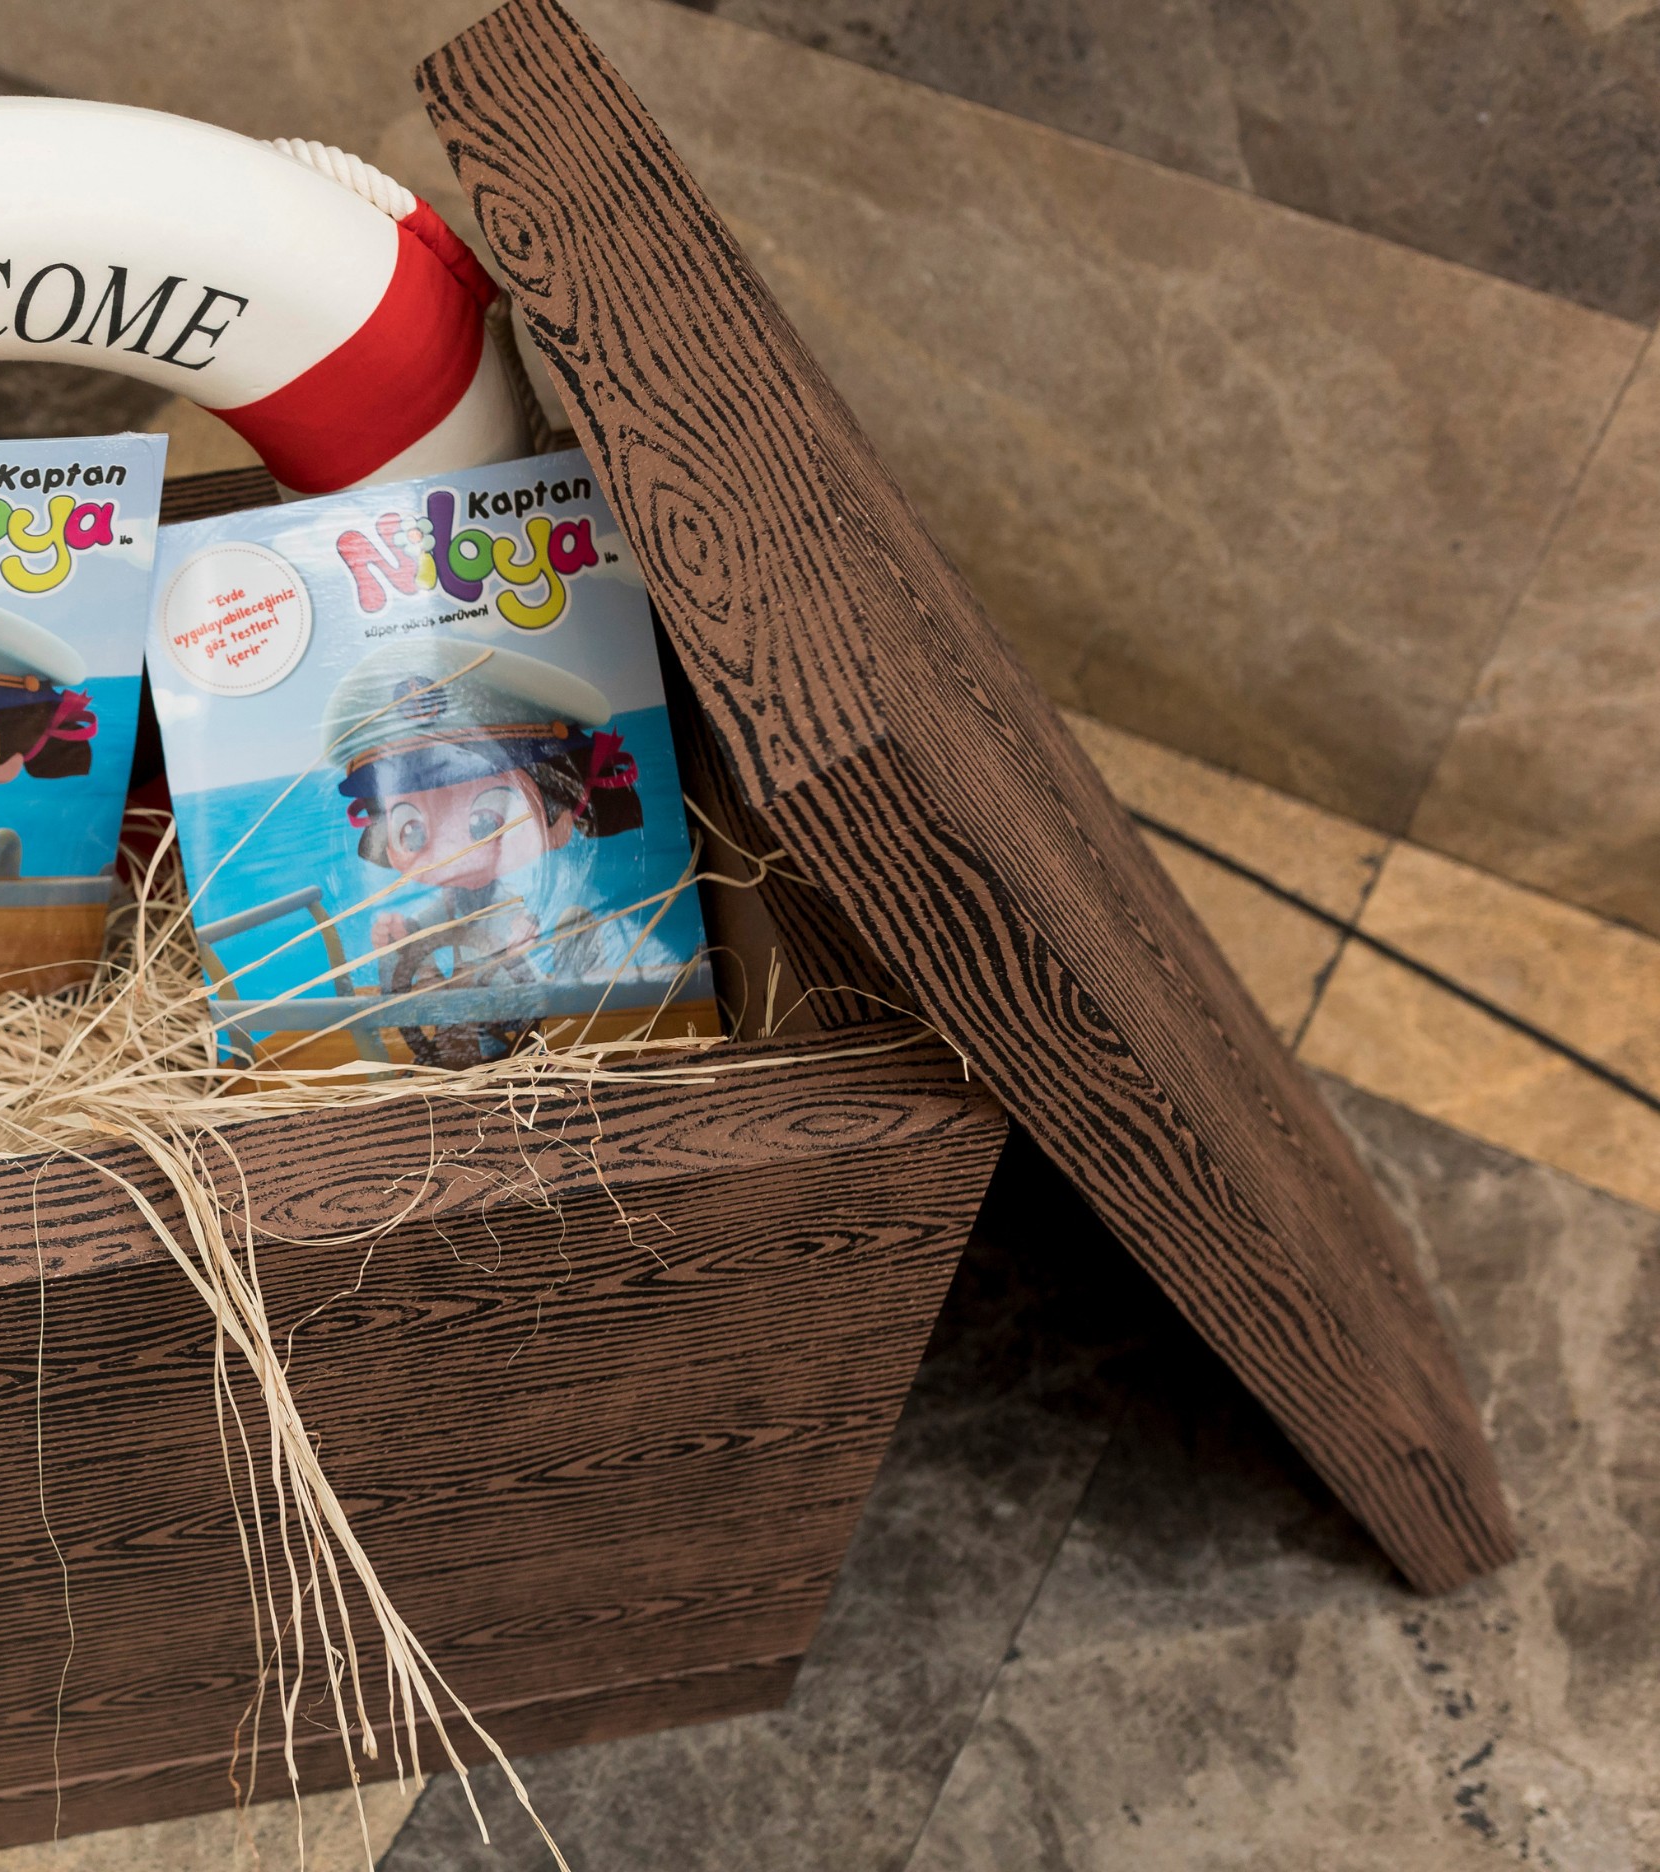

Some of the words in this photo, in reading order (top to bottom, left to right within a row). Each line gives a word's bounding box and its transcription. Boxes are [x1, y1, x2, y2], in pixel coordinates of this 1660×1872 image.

[468, 477, 591, 520] Kaptan
[336, 490, 599, 630] Niloya
[174, 588, 296, 648] uygulayabileceğiniz
[205, 638, 227, 659] göz
[231, 614, 279, 643] testleri
